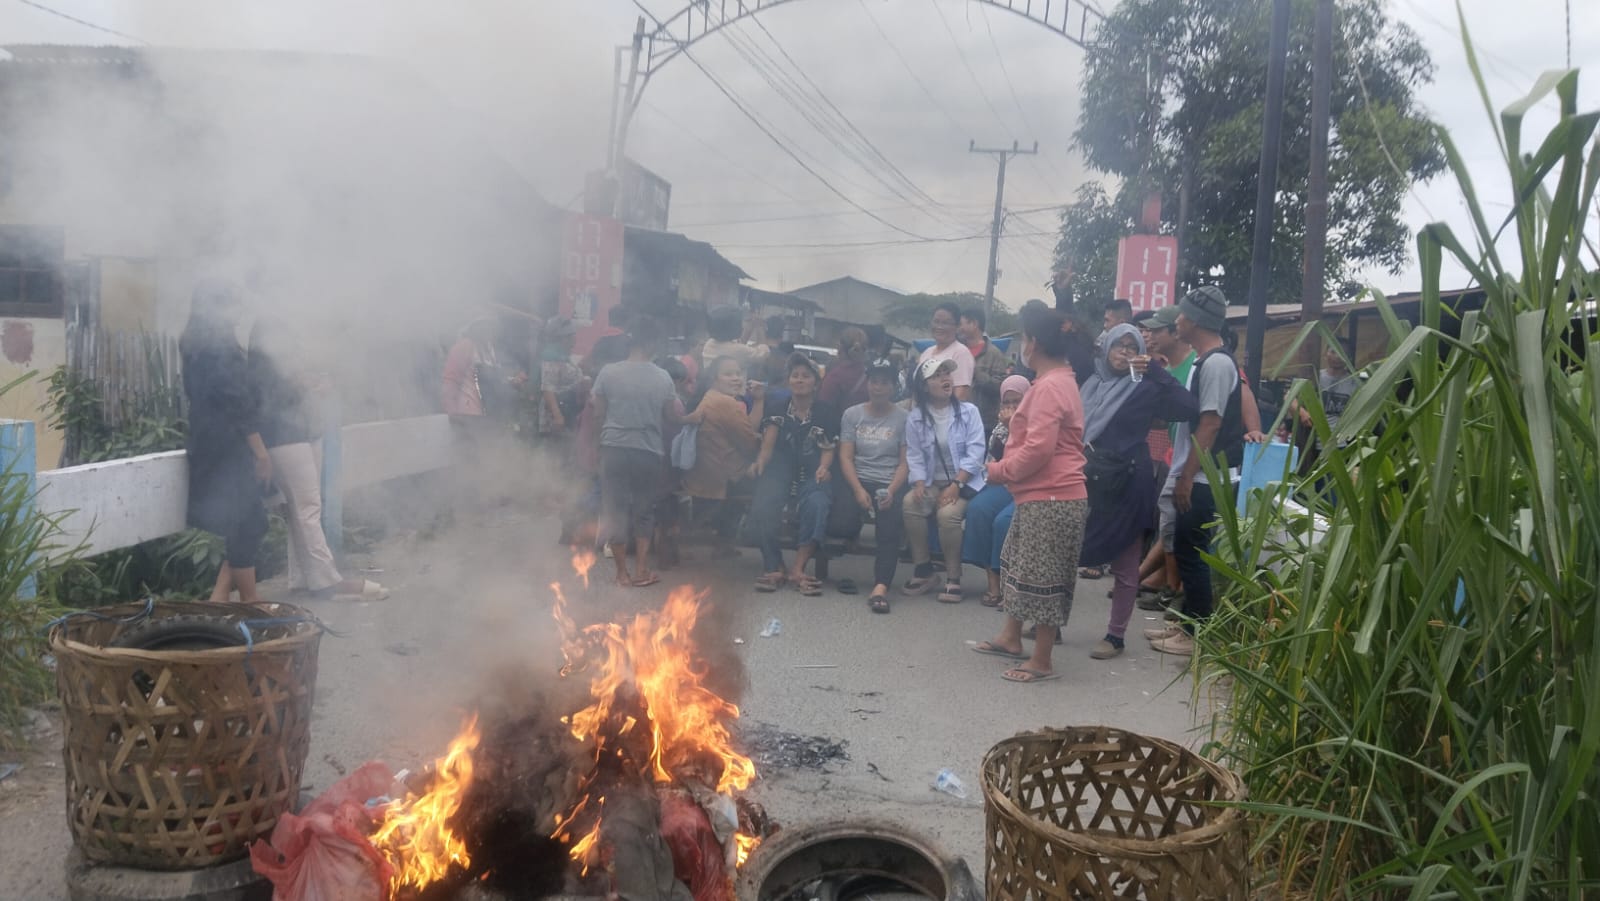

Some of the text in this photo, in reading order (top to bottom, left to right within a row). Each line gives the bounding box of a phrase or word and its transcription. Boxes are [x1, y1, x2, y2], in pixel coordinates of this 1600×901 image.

[578, 220, 601, 248] 17
[567, 251, 601, 281] 08
[1142, 246, 1172, 275] 17
[1128, 280, 1168, 311] 08
